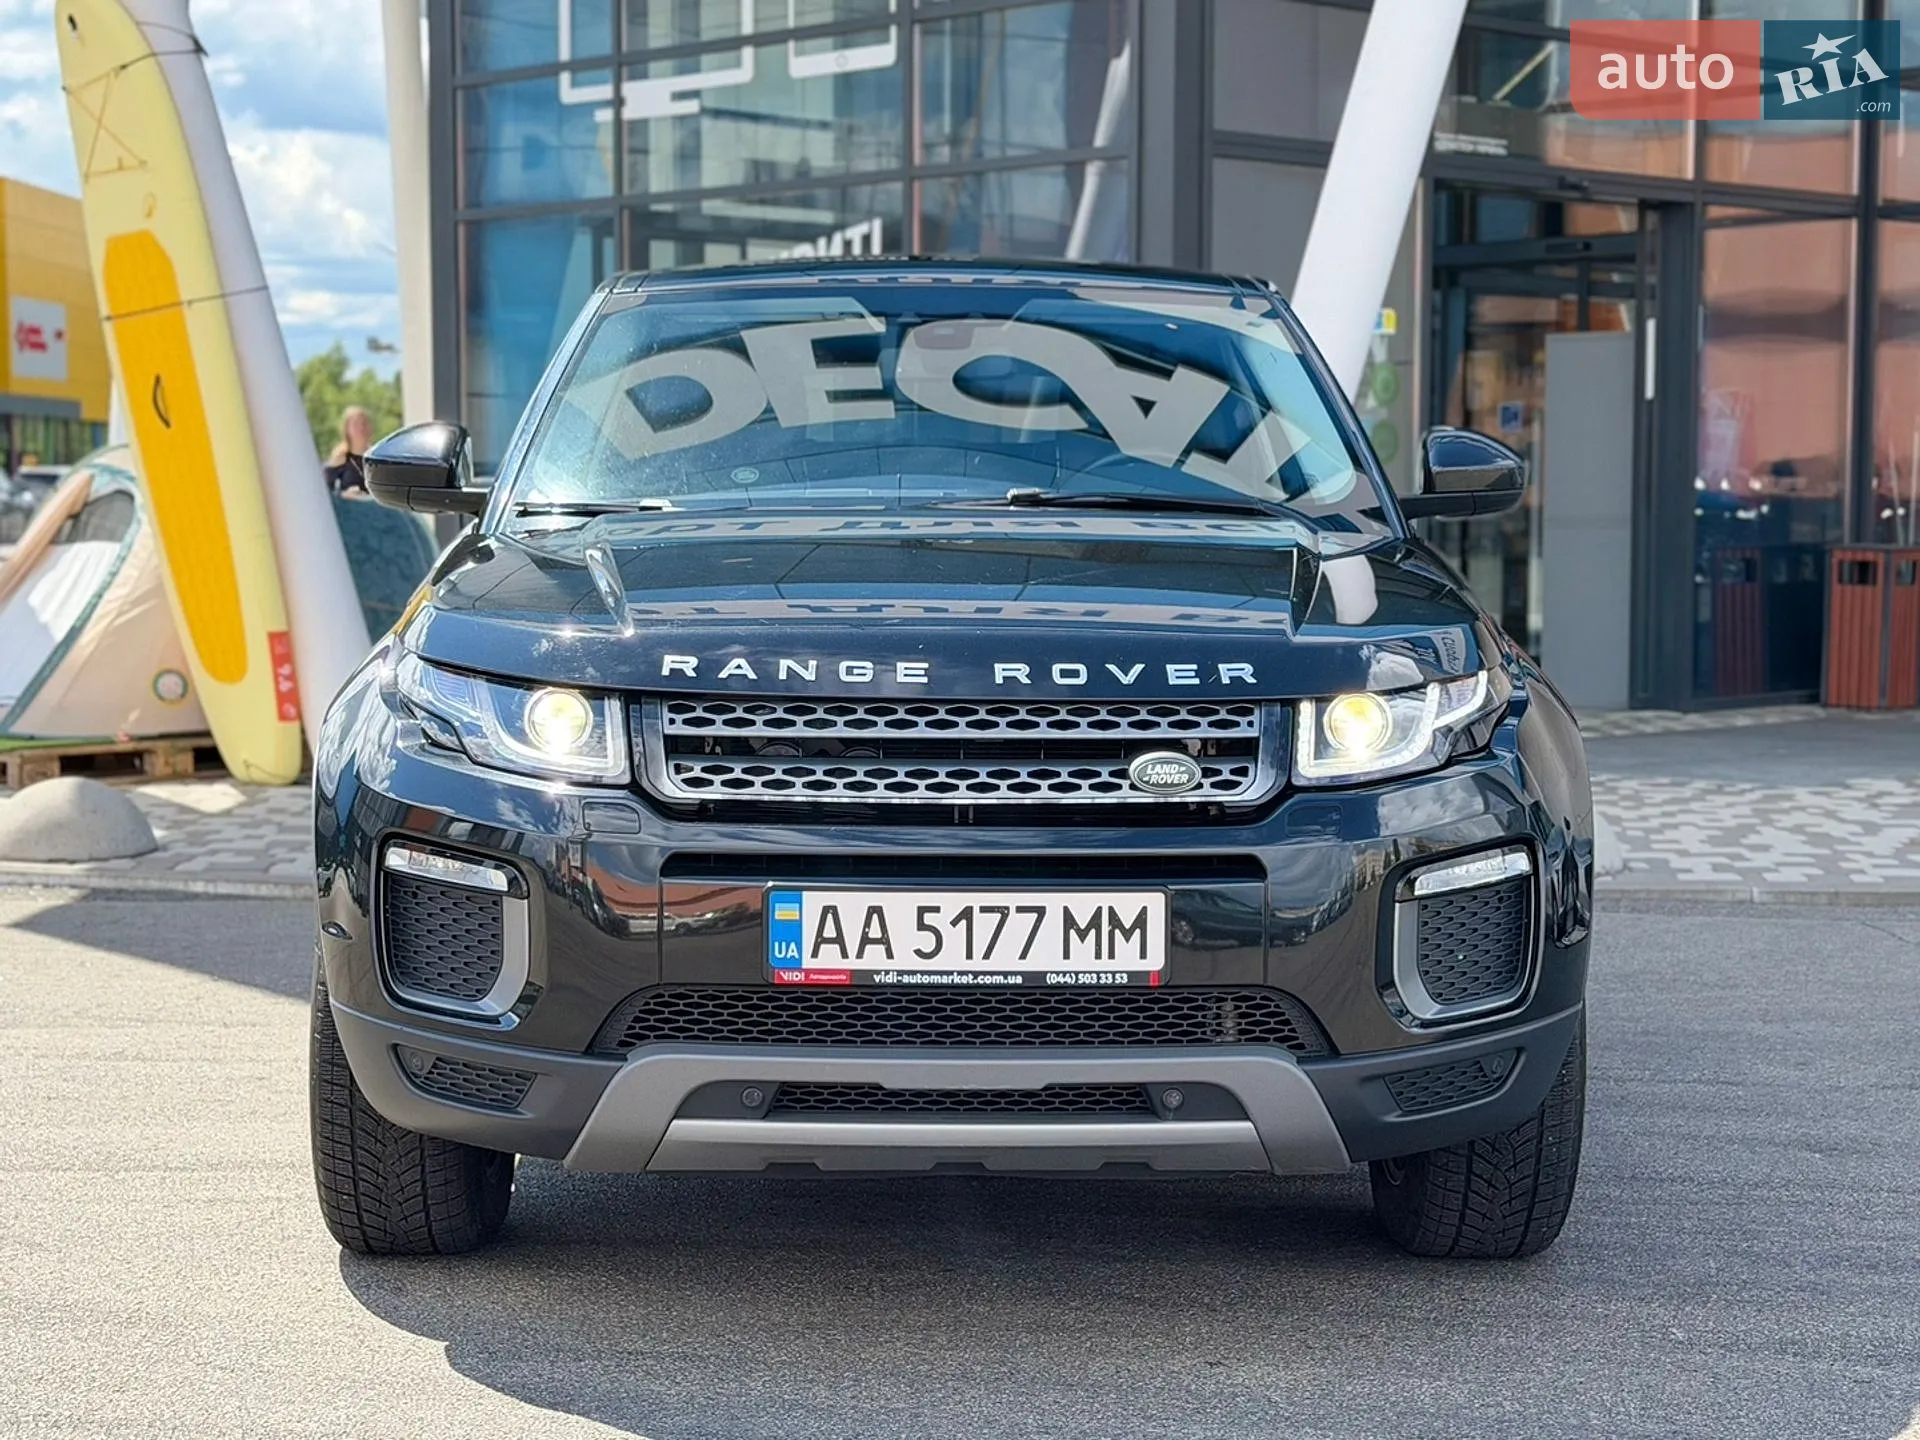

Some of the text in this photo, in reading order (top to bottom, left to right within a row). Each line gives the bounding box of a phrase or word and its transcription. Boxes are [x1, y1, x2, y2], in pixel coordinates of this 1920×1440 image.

[660, 654, 1258, 687] RANGE ROVER
[1146, 764, 1178, 774] LAND
[1149, 773, 1190, 784] ROVER
[810, 904, 1148, 961] AA 5177 MM
[774, 941, 799, 959] UA
[780, 971, 806, 981] VIDI
[873, 972, 1023, 985] vidi-automarket.com.ua
[1045, 973, 1128, 985] (044) 503 33 53
